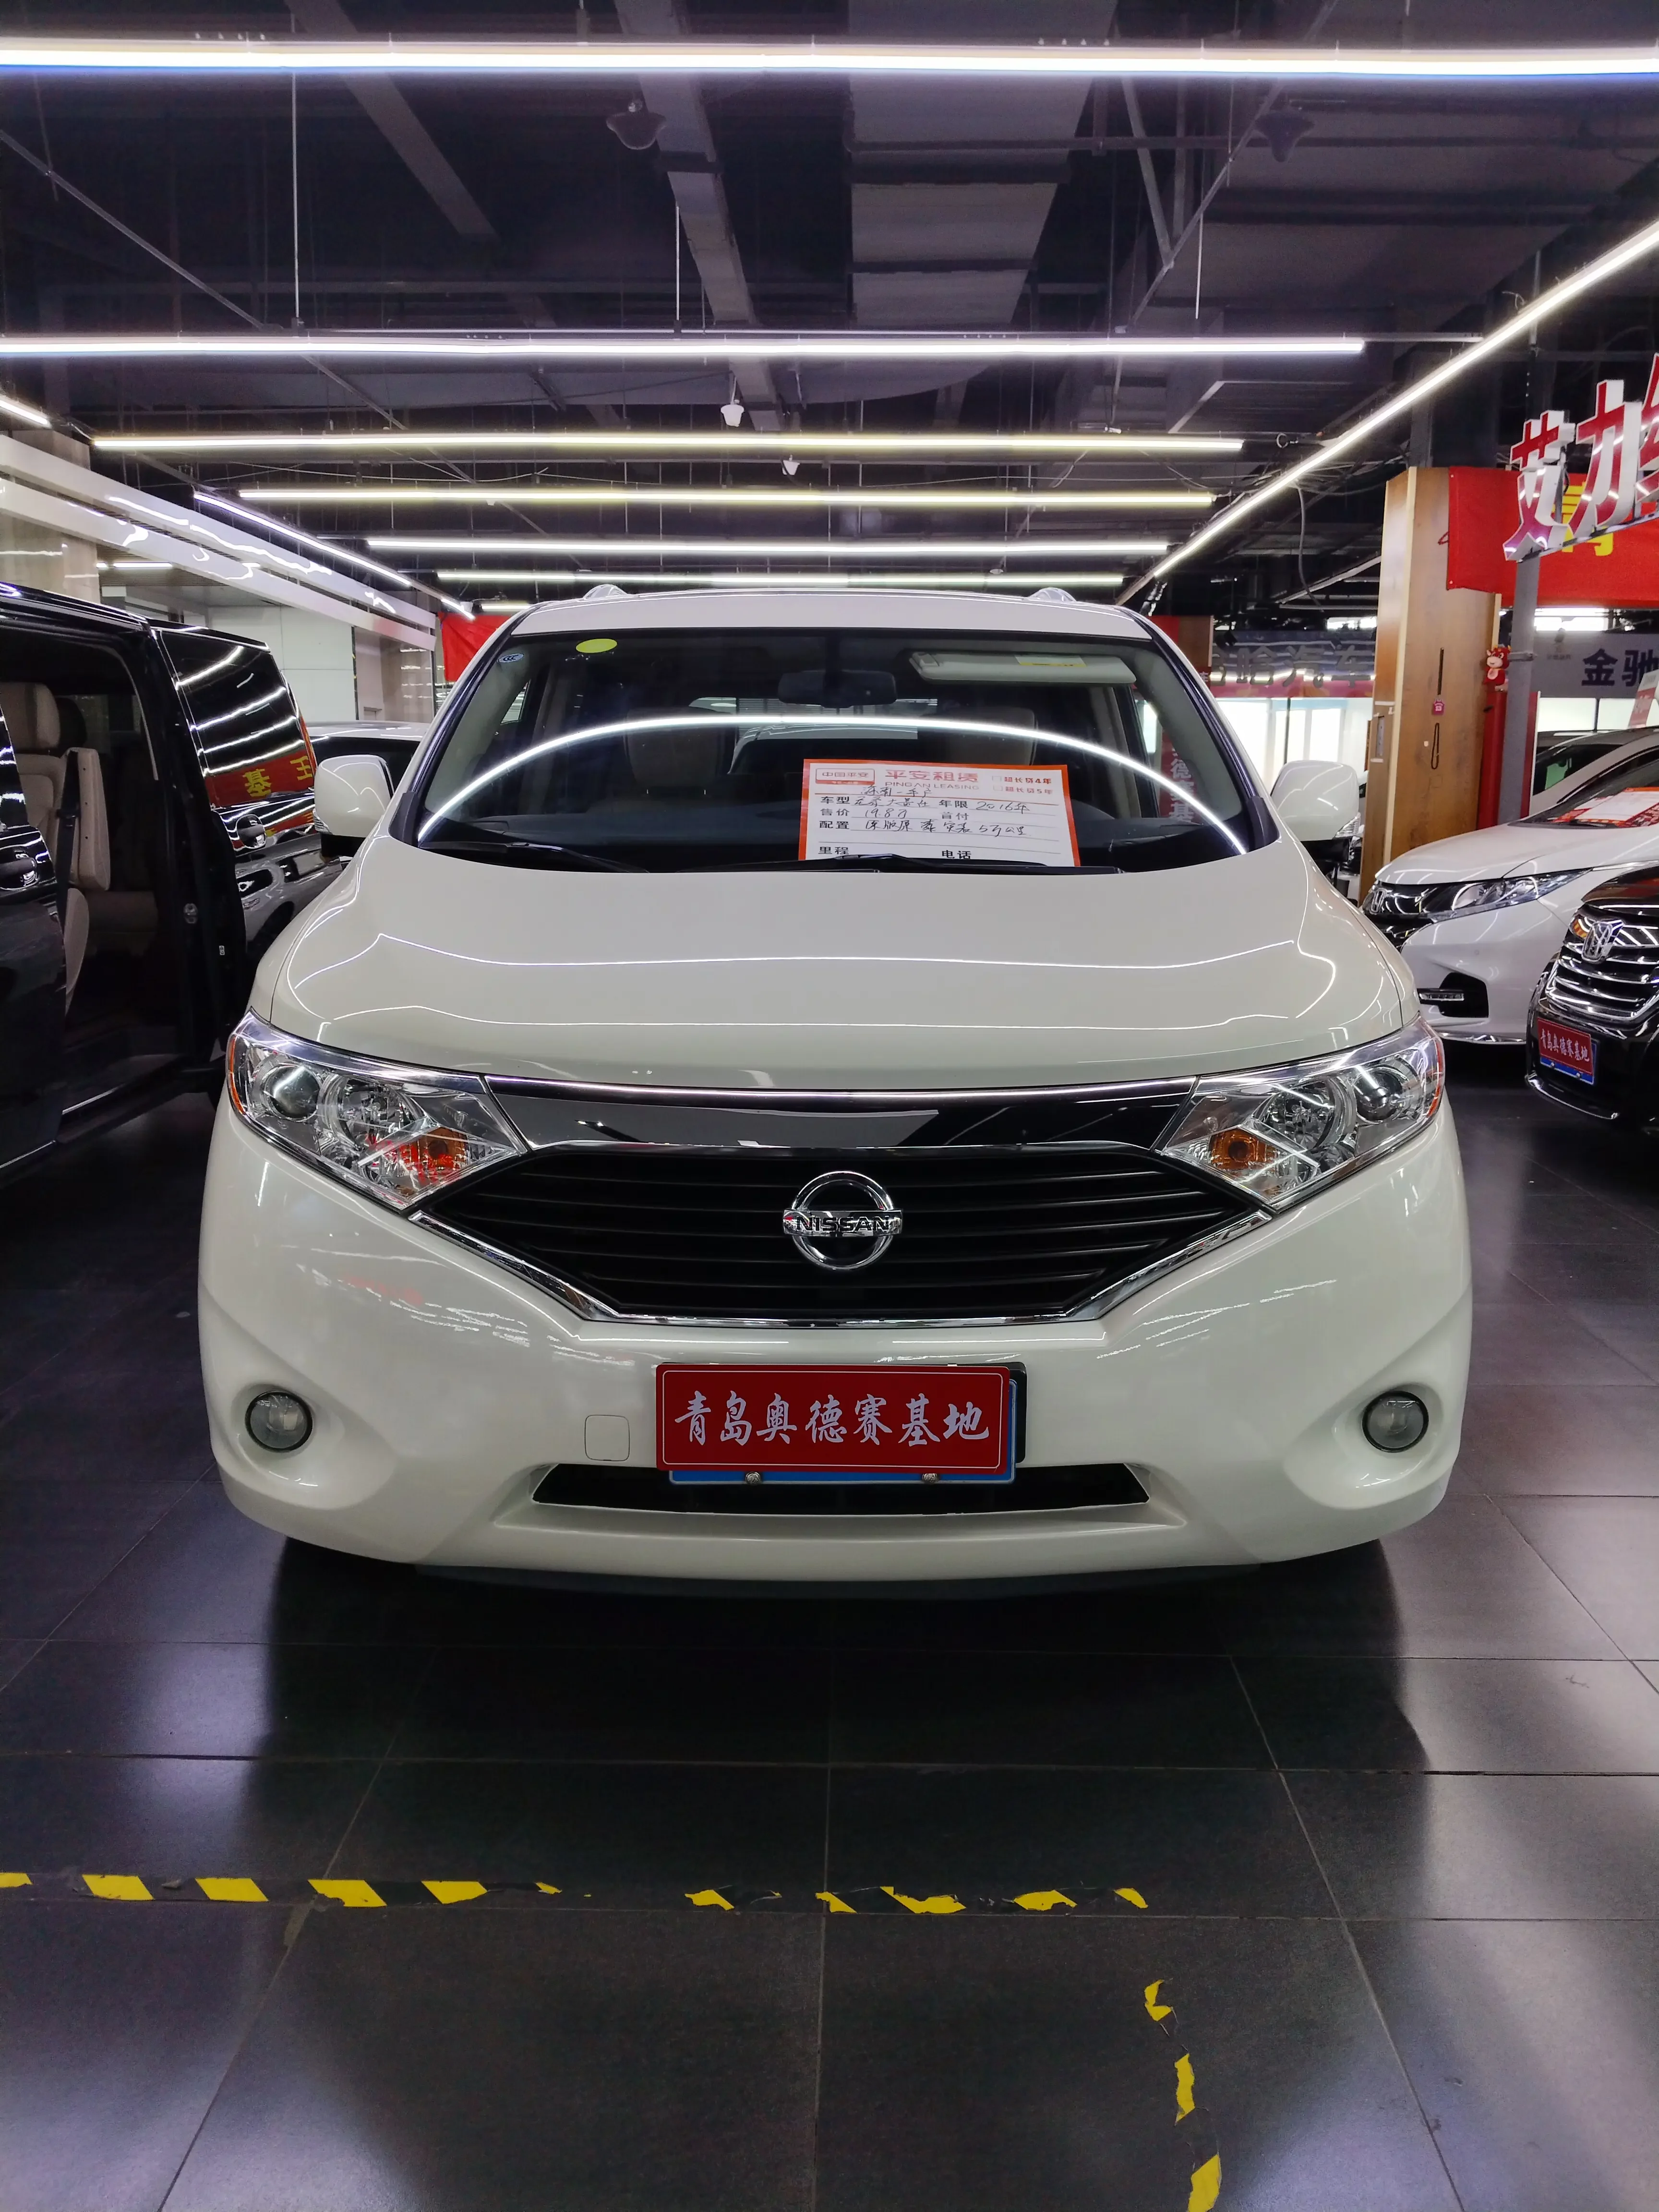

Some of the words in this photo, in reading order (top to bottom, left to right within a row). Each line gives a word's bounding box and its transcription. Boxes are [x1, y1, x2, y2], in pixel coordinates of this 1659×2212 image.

[885, 769, 978, 782] 平安租赁
[820, 796, 850, 805] 车型
[939, 800, 968, 808] 年限
[976, 801, 1030, 814] 2016年
[941, 812, 969, 820] 首付
[819, 821, 850, 830] 配置
[818, 846, 850, 855] 里程
[941, 850, 972, 859] 电话
[795, 1215, 889, 1232] NISSAN
[675, 1391, 989, 1446] 青岛奥德赛基地
